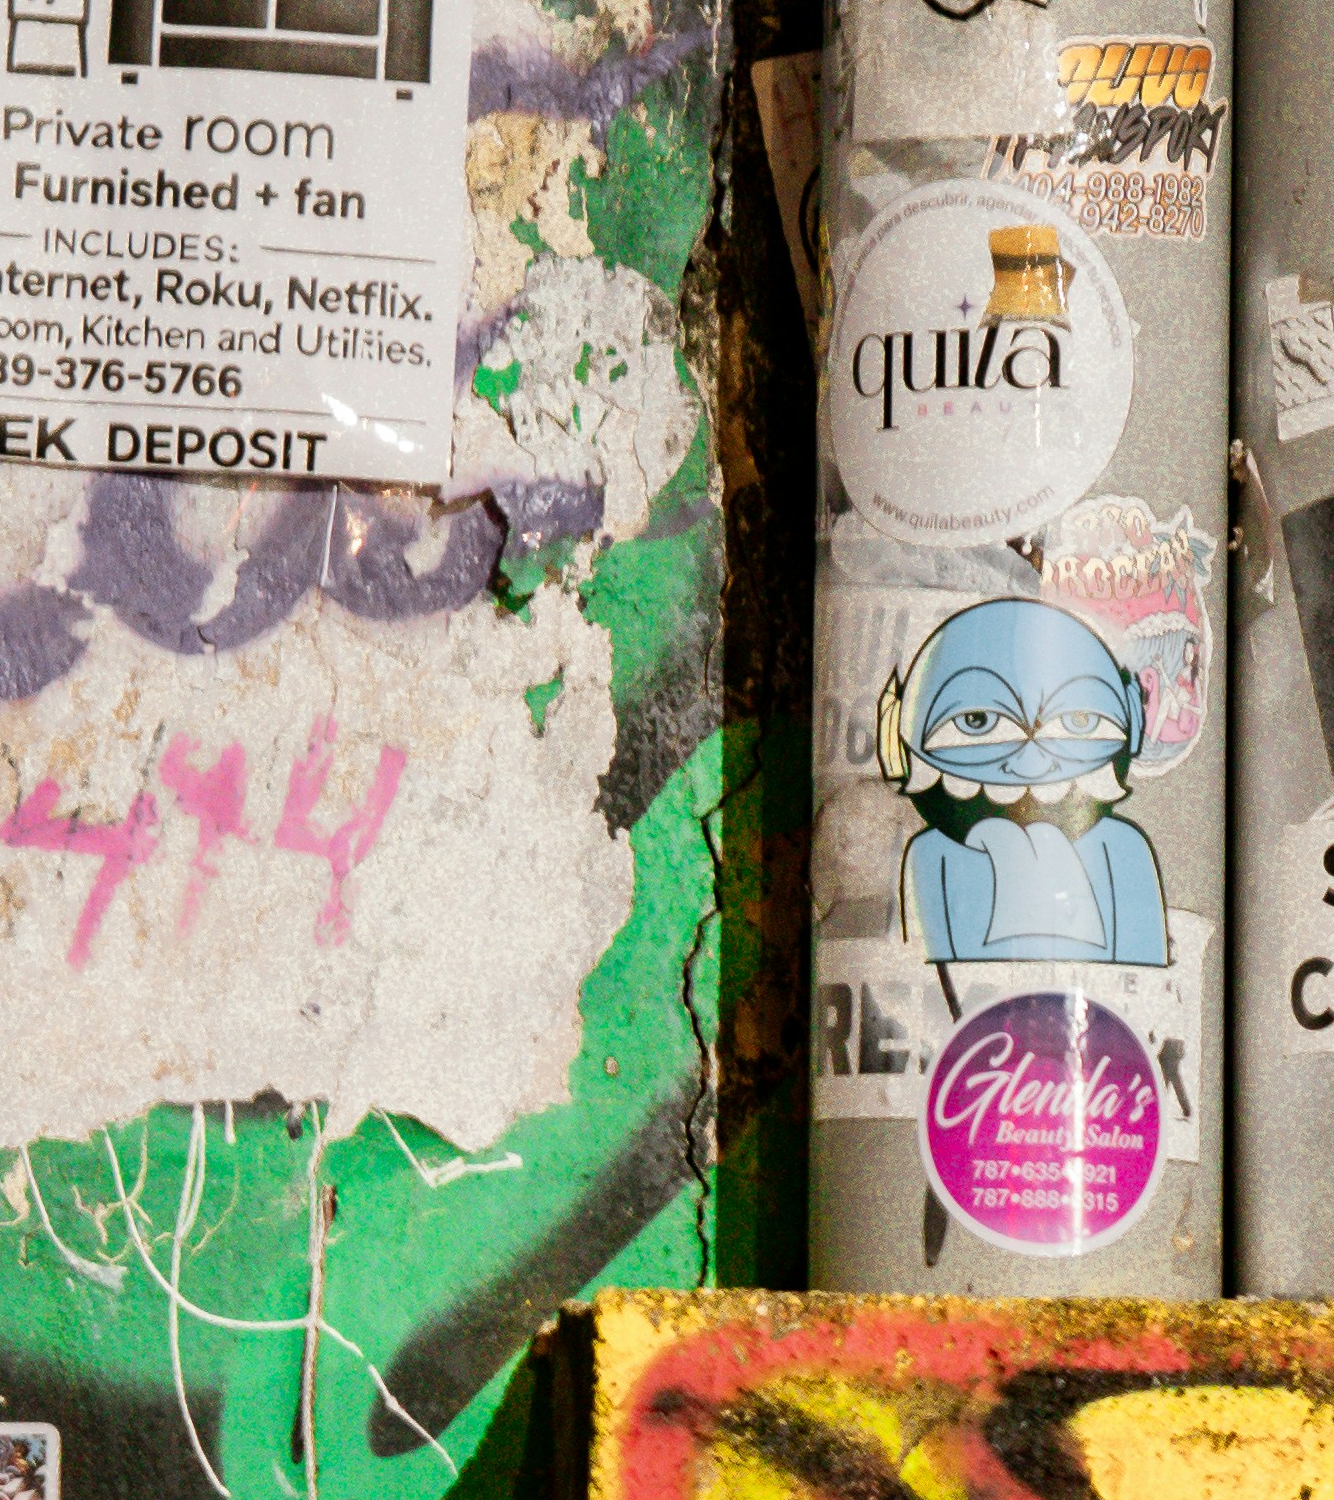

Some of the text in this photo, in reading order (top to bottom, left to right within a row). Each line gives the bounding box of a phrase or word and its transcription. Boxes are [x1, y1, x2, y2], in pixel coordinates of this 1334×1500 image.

[3, 104, 163, 152] Private
[183, 114, 335, 161] room
[14, 161, 239, 213] Furnished
[293, 176, 367, 222] fan
[42, 227, 242, 264] INCLUDES:
[154, 270, 272, 317] Roku,
[286, 277, 434, 324] Netflix.
[80, 313, 206, 354] Kitchen
[218, 324, 282, 358] and
[106, 423, 330, 474] DEPOSIT
[1084, 1123, 1145, 1151] Salon
